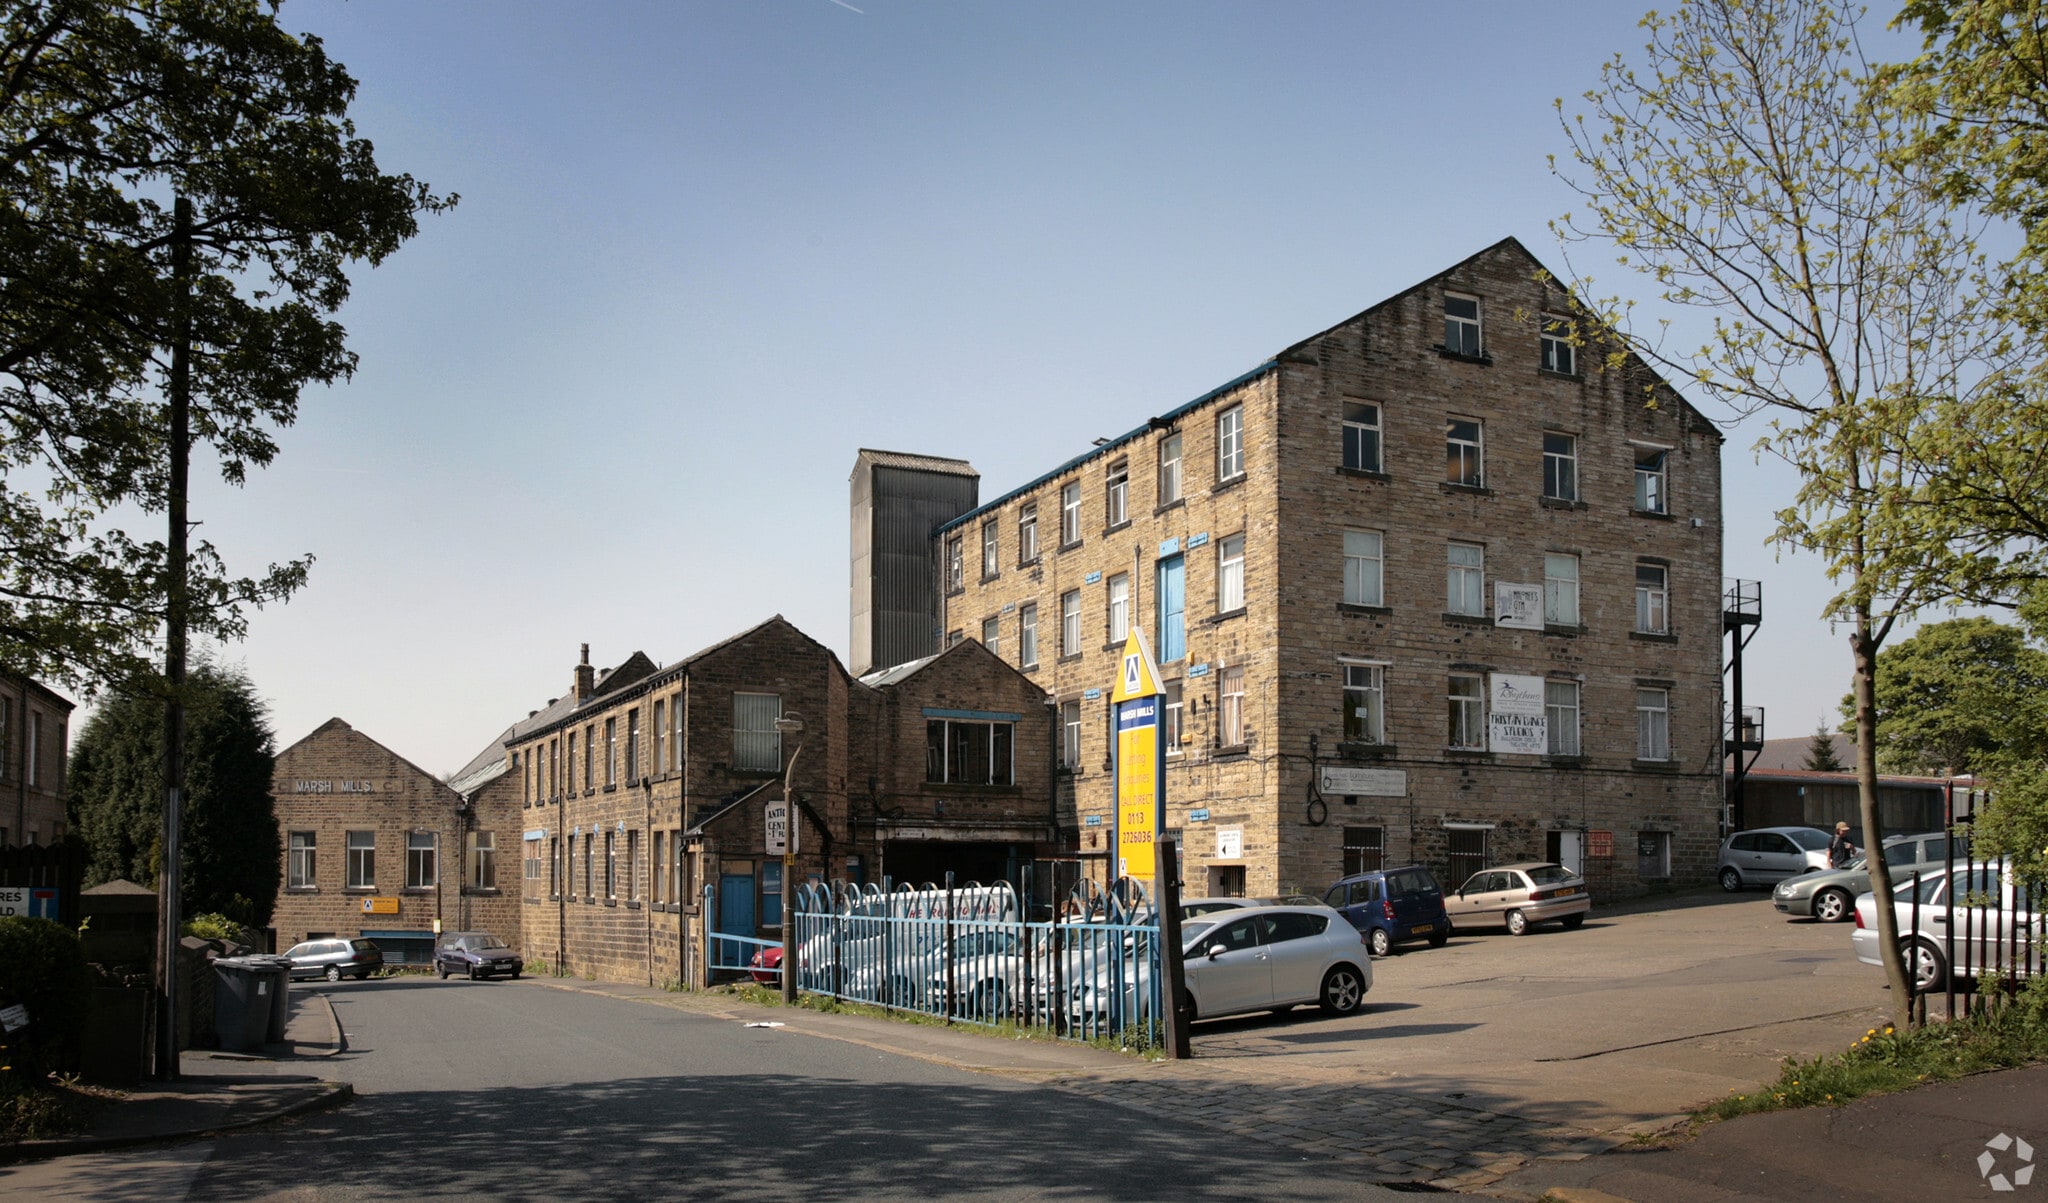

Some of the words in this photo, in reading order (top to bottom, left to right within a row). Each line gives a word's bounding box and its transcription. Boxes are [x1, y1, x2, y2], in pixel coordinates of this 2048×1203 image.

[1120, 709, 1137, 721] MARSH
[1136, 705, 1154, 718] MILLS
[1503, 726, 1534, 737] STUDIOS
[296, 780, 332, 793] MARSH
[341, 780, 375, 793] MILLS.
[1121, 796, 1133, 807] CALL
[1133, 793, 1153, 806] DIRECT
[1128, 812, 1145, 825] 0113
[1122, 831, 1152, 844] 2726036
